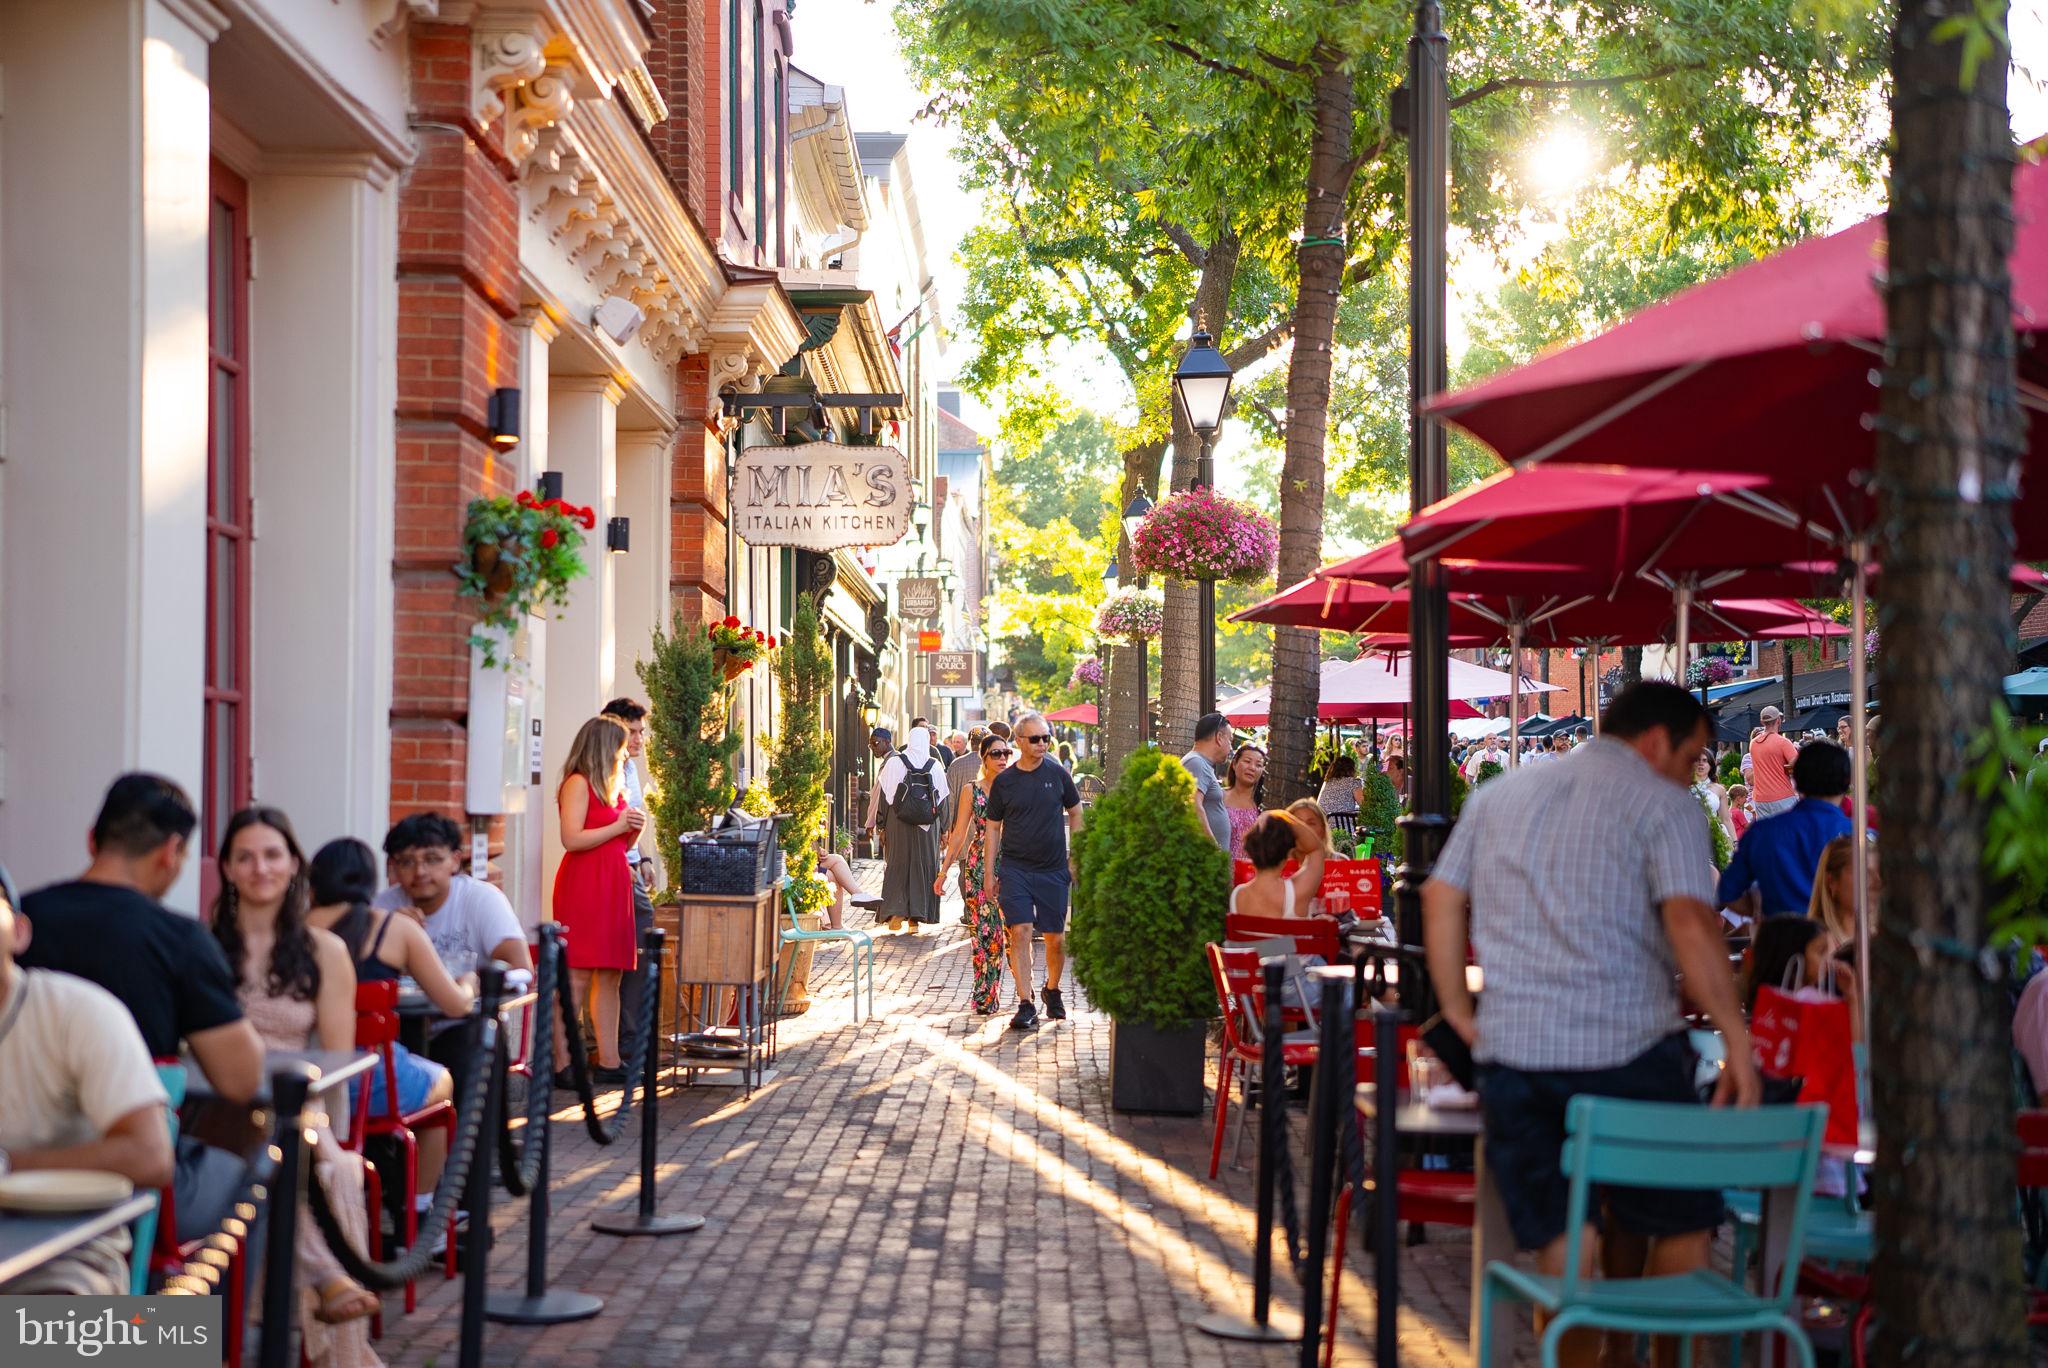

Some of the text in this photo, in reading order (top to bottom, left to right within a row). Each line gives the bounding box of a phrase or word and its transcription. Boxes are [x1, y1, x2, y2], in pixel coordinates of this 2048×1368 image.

[747, 462, 896, 508] MIA'S
[747, 515, 896, 530] ITALIAN KITCHEN
[938, 655, 964, 663] PAPER
[935, 662, 967, 670] SOURCE
